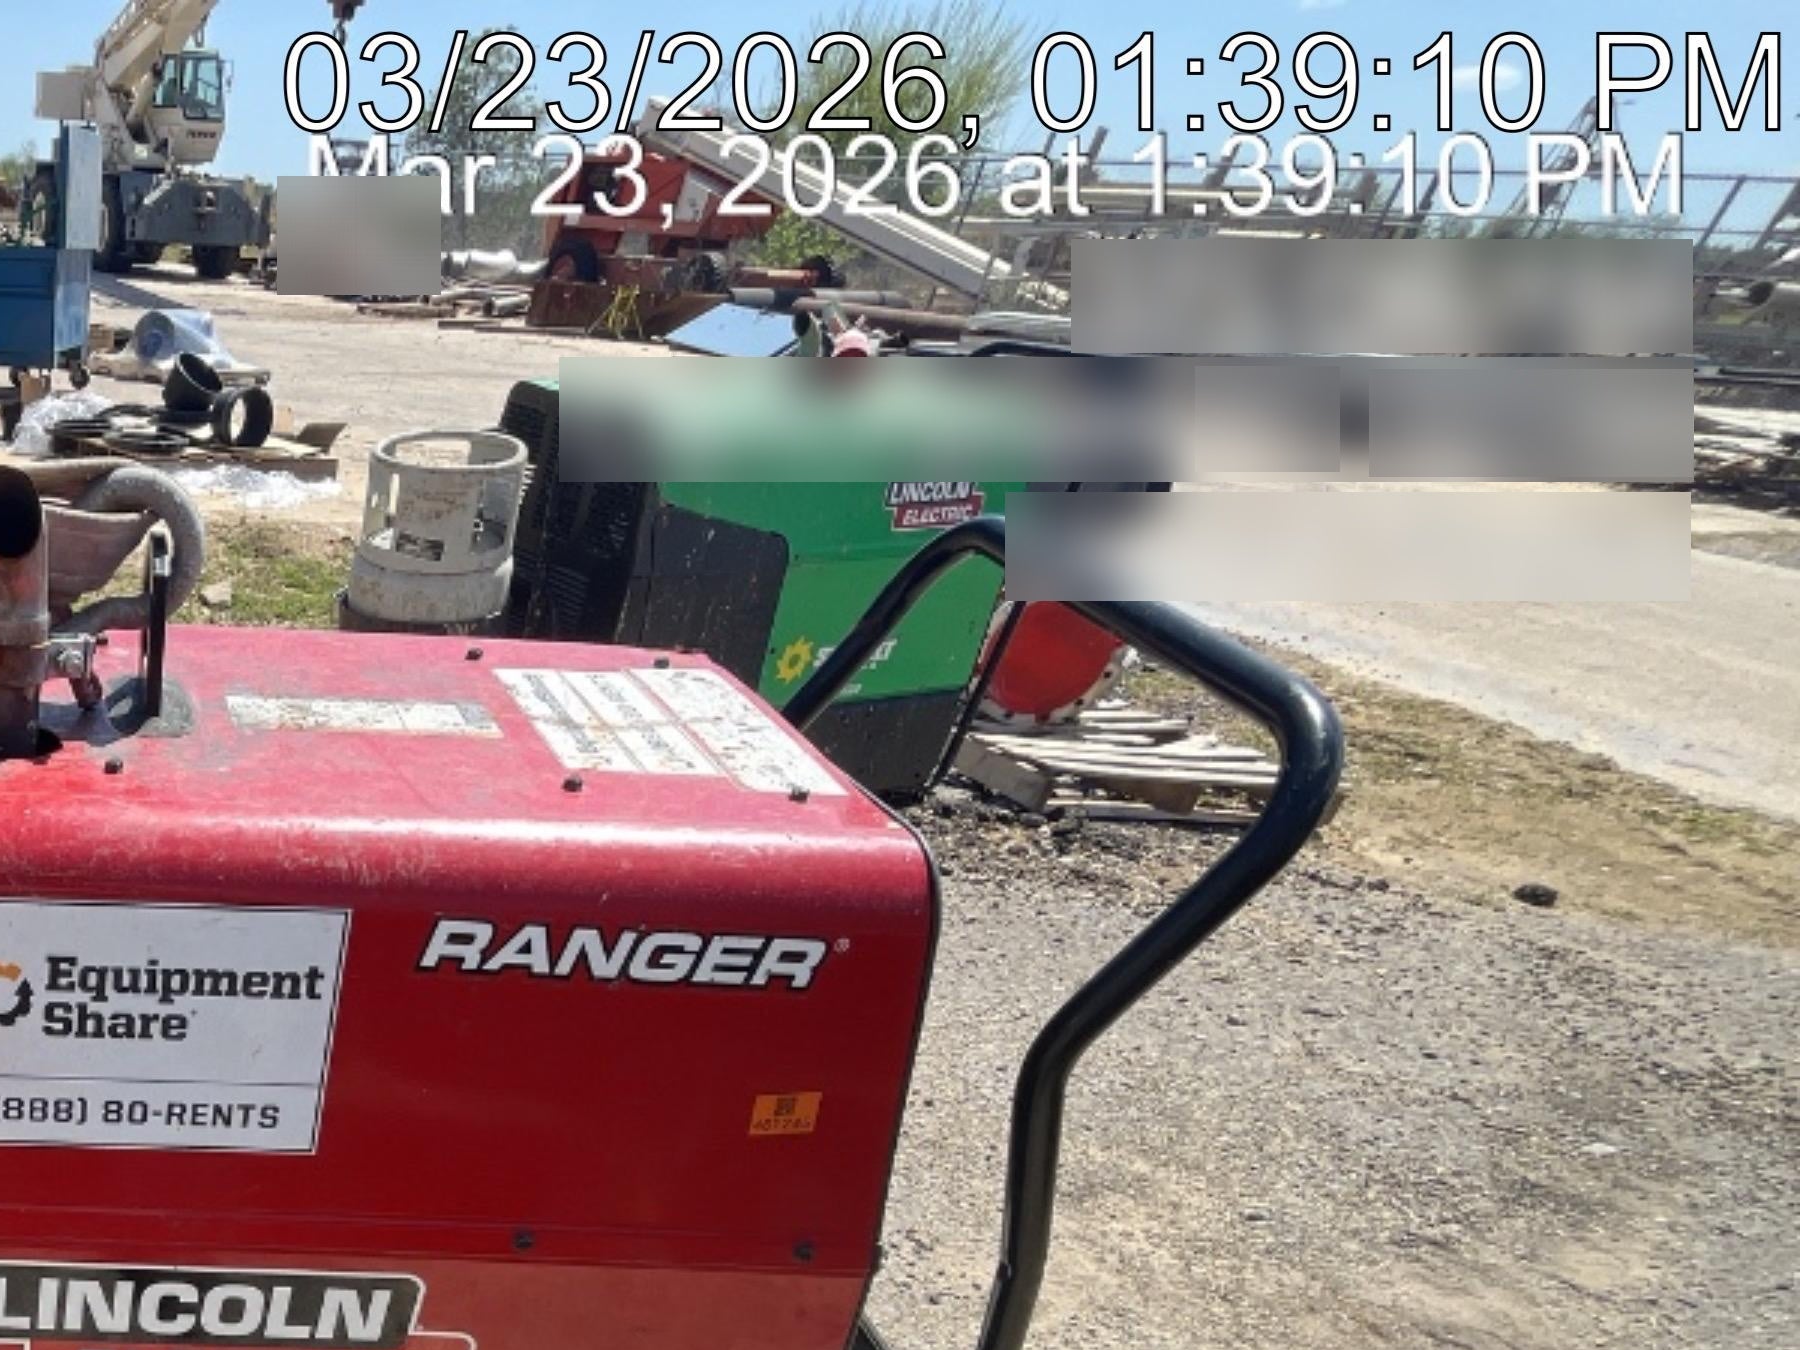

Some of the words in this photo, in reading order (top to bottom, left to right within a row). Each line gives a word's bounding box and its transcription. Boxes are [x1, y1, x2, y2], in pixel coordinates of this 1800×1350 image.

[889, 482, 970, 504] LINCOLN
[902, 503, 974, 527] ELECTRIC
[419, 919, 829, 992] RANGER
[44, 955, 325, 1004] Equipment
[42, 1002, 189, 1041] Share
[101, 1100, 281, 1129] 80-RENTS
